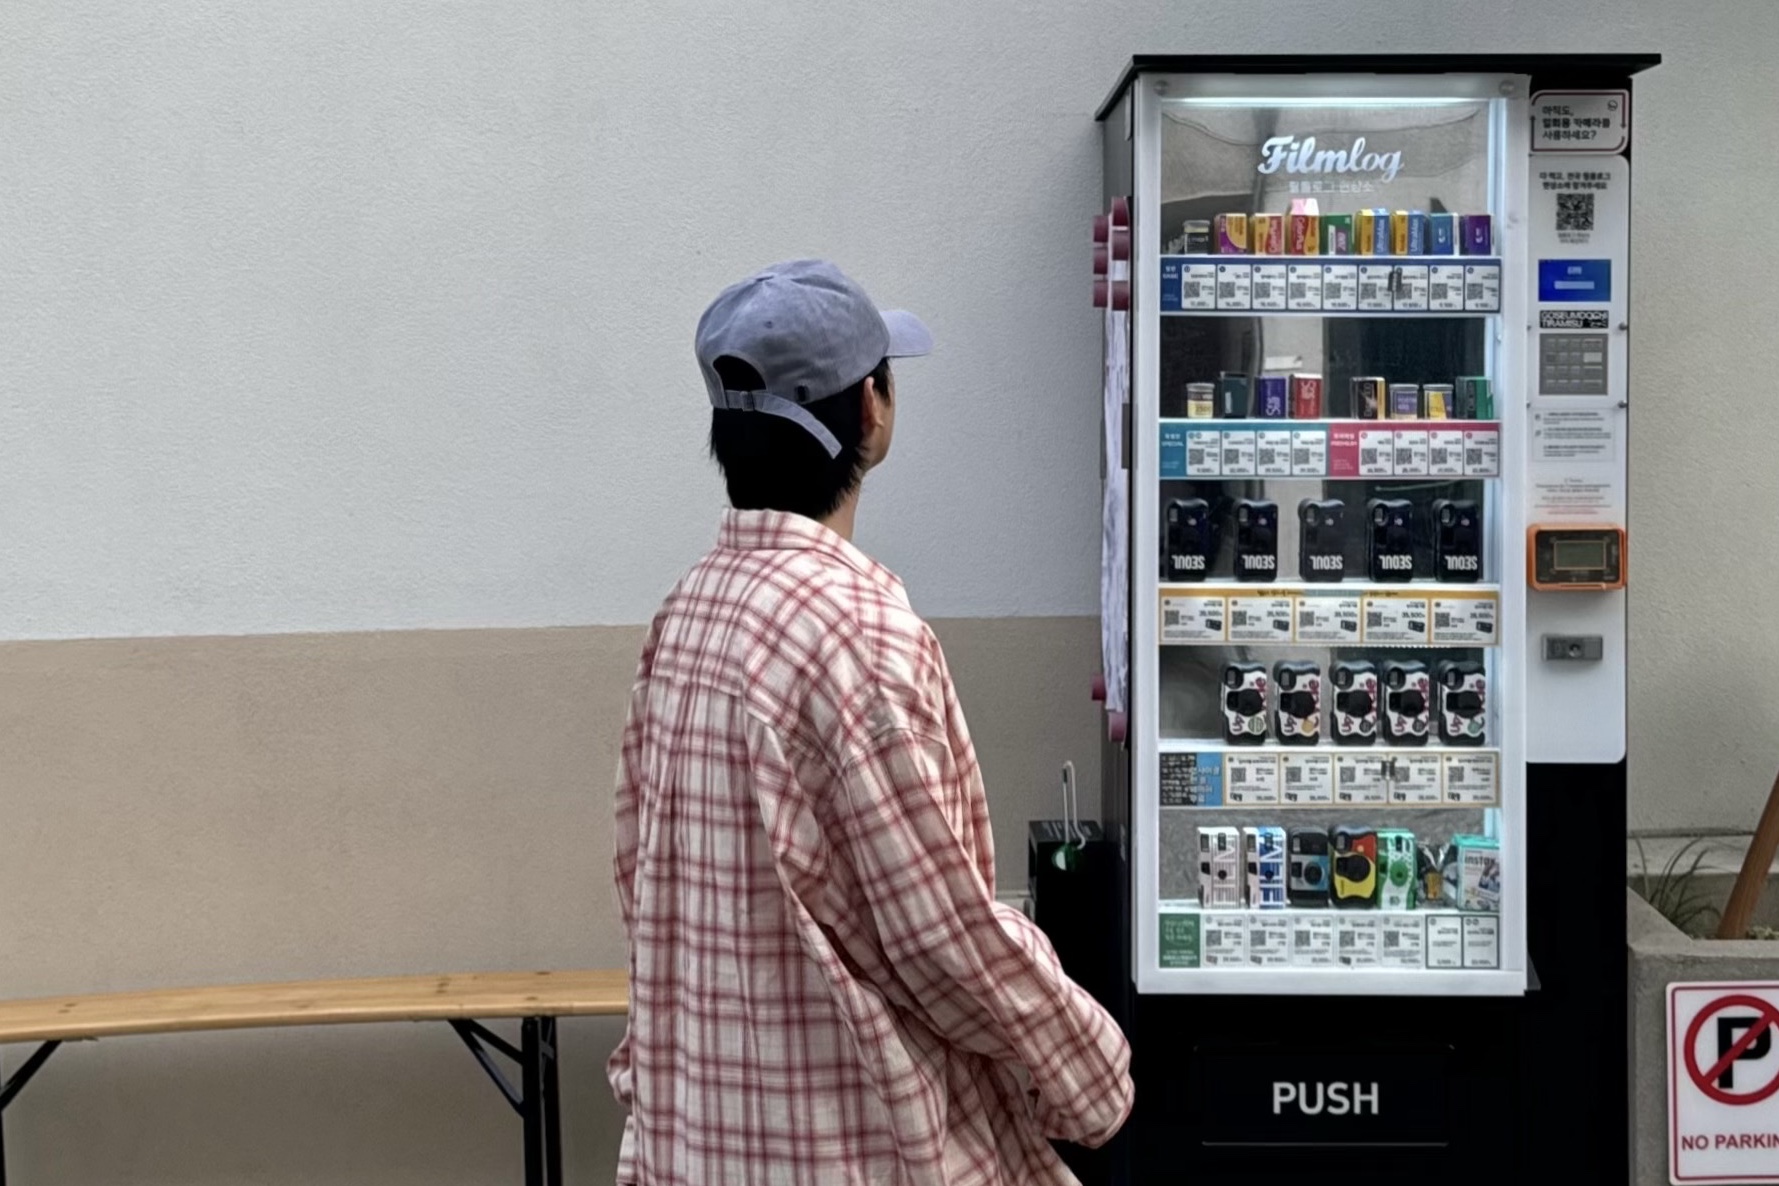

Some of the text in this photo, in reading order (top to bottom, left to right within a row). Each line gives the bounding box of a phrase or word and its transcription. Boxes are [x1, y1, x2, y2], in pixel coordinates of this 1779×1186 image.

[1542, 130, 1597, 140] 사용하세요?
[1257, 135, 1405, 183] Filmlog
[1171, 554, 1206, 570] SEOUL
[1241, 554, 1276, 570] SEOUL
[1309, 554, 1344, 570] SEOUL
[1378, 554, 1413, 570] SEOUL
[1444, 555, 1478, 571] SEOUL
[1273, 1081, 1379, 1115] PUSH
[1681, 1134, 1709, 1151] NO
